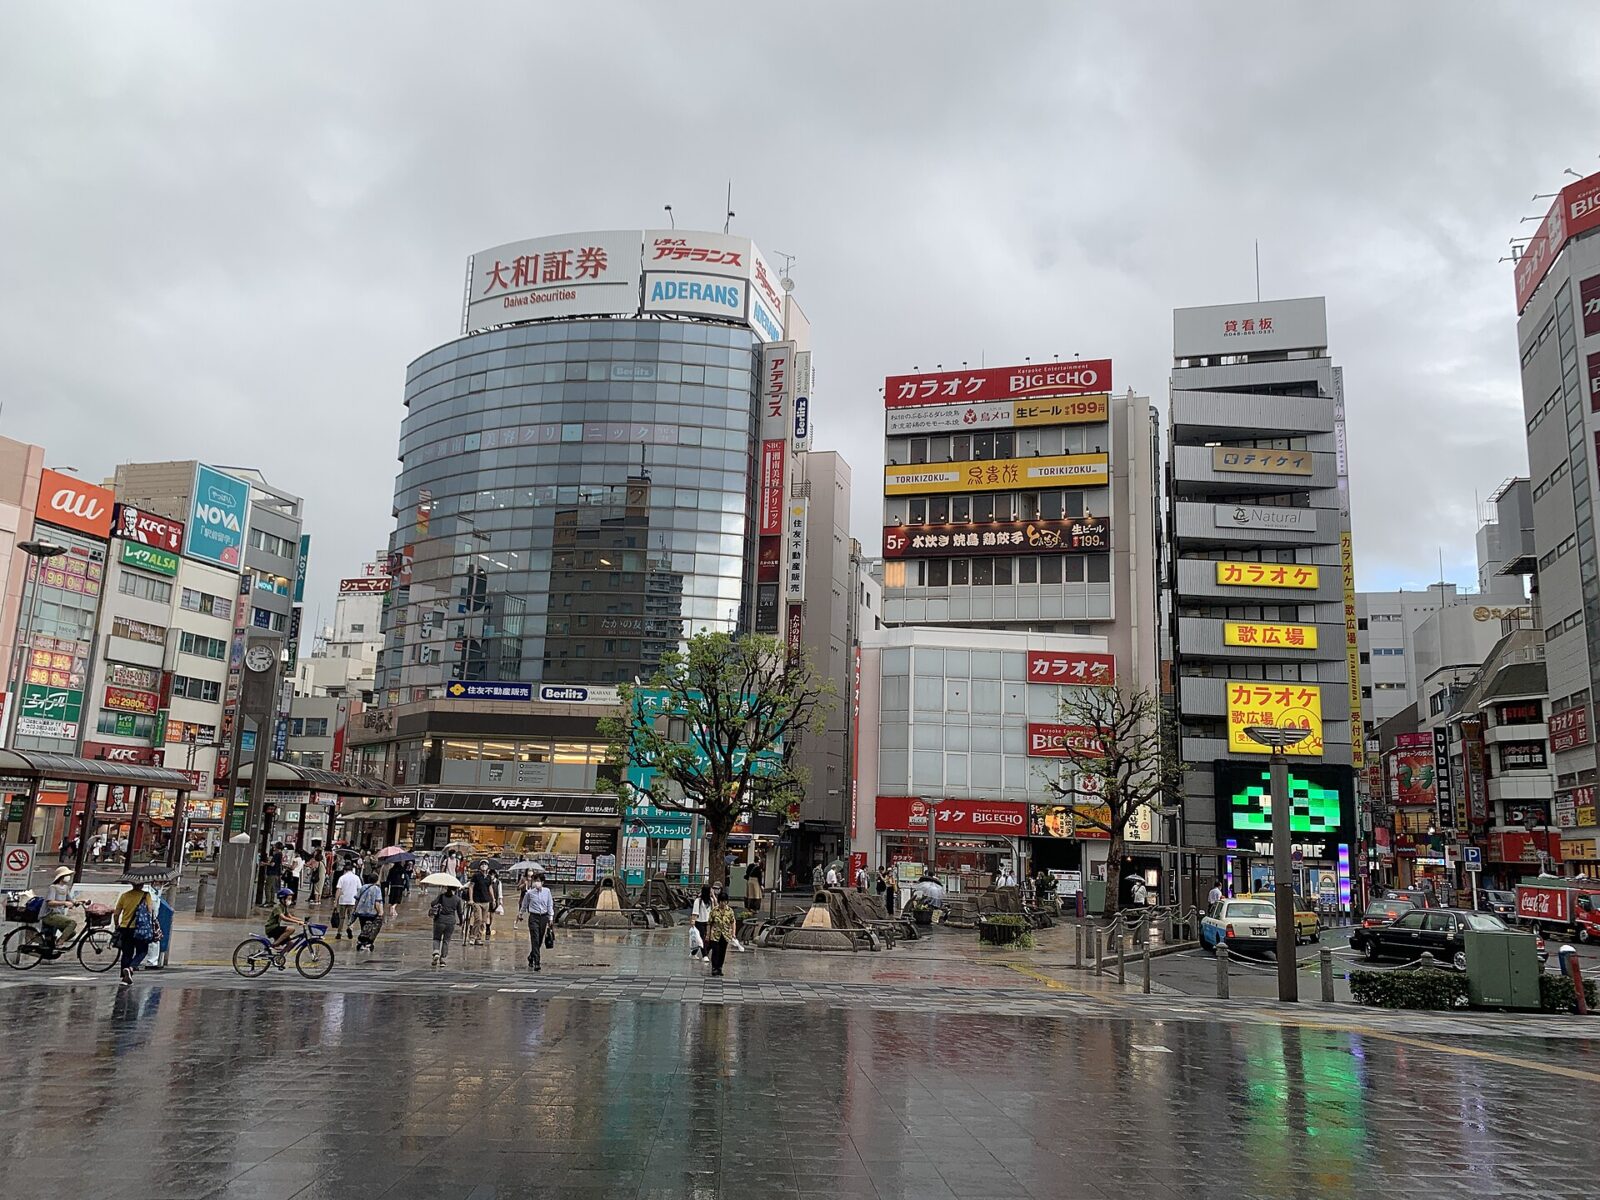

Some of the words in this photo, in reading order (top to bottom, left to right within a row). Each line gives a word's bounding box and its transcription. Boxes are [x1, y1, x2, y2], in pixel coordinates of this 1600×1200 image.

[653, 238, 687, 247] レディス
[652, 246, 742, 267] アデランス
[484, 247, 608, 295] 大和証券
[504, 296, 528, 309] Daiwa
[530, 289, 577, 304] Securities
[651, 281, 739, 309] ADERANS
[754, 266, 782, 314] アデランス
[754, 300, 780, 341] ADERANS
[1224, 318, 1273, 332] 貸看板
[1044, 363, 1089, 372] Entertainment
[767, 359, 785, 417] アデランス
[897, 376, 987, 399] カラオケ
[1010, 375, 1043, 392] BIG
[1046, 370, 1098, 386] ECHO
[796, 400, 806, 435] Berlitz
[980, 411, 1010, 422] 鳥メロ
[1016, 406, 1062, 418] 生ビール
[896, 474, 945, 484] TORIKIZOKU
[968, 464, 1018, 486] 鳥貴族
[1038, 465, 1092, 476] TORIKIZOKU
[770, 452, 781, 528] 湘南美容クリニック
[50, 488, 104, 520] au
[196, 502, 241, 533] NOVA
[1251, 508, 1302, 523] Natural
[138, 517, 167, 536] KFC
[1071, 523, 1104, 535] 生ビール
[886, 535, 906, 550] 5F
[912, 534, 950, 549] 水炊き
[952, 533, 979, 547] 焼鳥
[982, 531, 1024, 546] 鶏餃子
[790, 519, 802, 593] 住友不動産販売
[1341, 537, 1352, 587] カラオケ
[1224, 565, 1312, 585] カラオケ
[1345, 604, 1357, 644] 歌広場
[1237, 626, 1304, 645] 歌広場
[1032, 658, 1109, 677] カラオケ
[467, 686, 529, 697] 住友不動産販売
[545, 687, 584, 700] Berlitz
[1232, 685, 1318, 708] カラオケ
[22, 692, 69, 711] エイブル
[1231, 711, 1274, 726] 歌広場
[1551, 713, 1574, 733] カラオケ
[1351, 711, 1363, 763] 受付4階
[107, 748, 140, 760] KFC
[288, 812, 299, 820] UQ
[972, 812, 993, 823] BIG
[994, 813, 1023, 825] ECHO
[638, 825, 693, 836] ハウス・トゥ・ハウ
[1468, 849, 1478, 862] P
